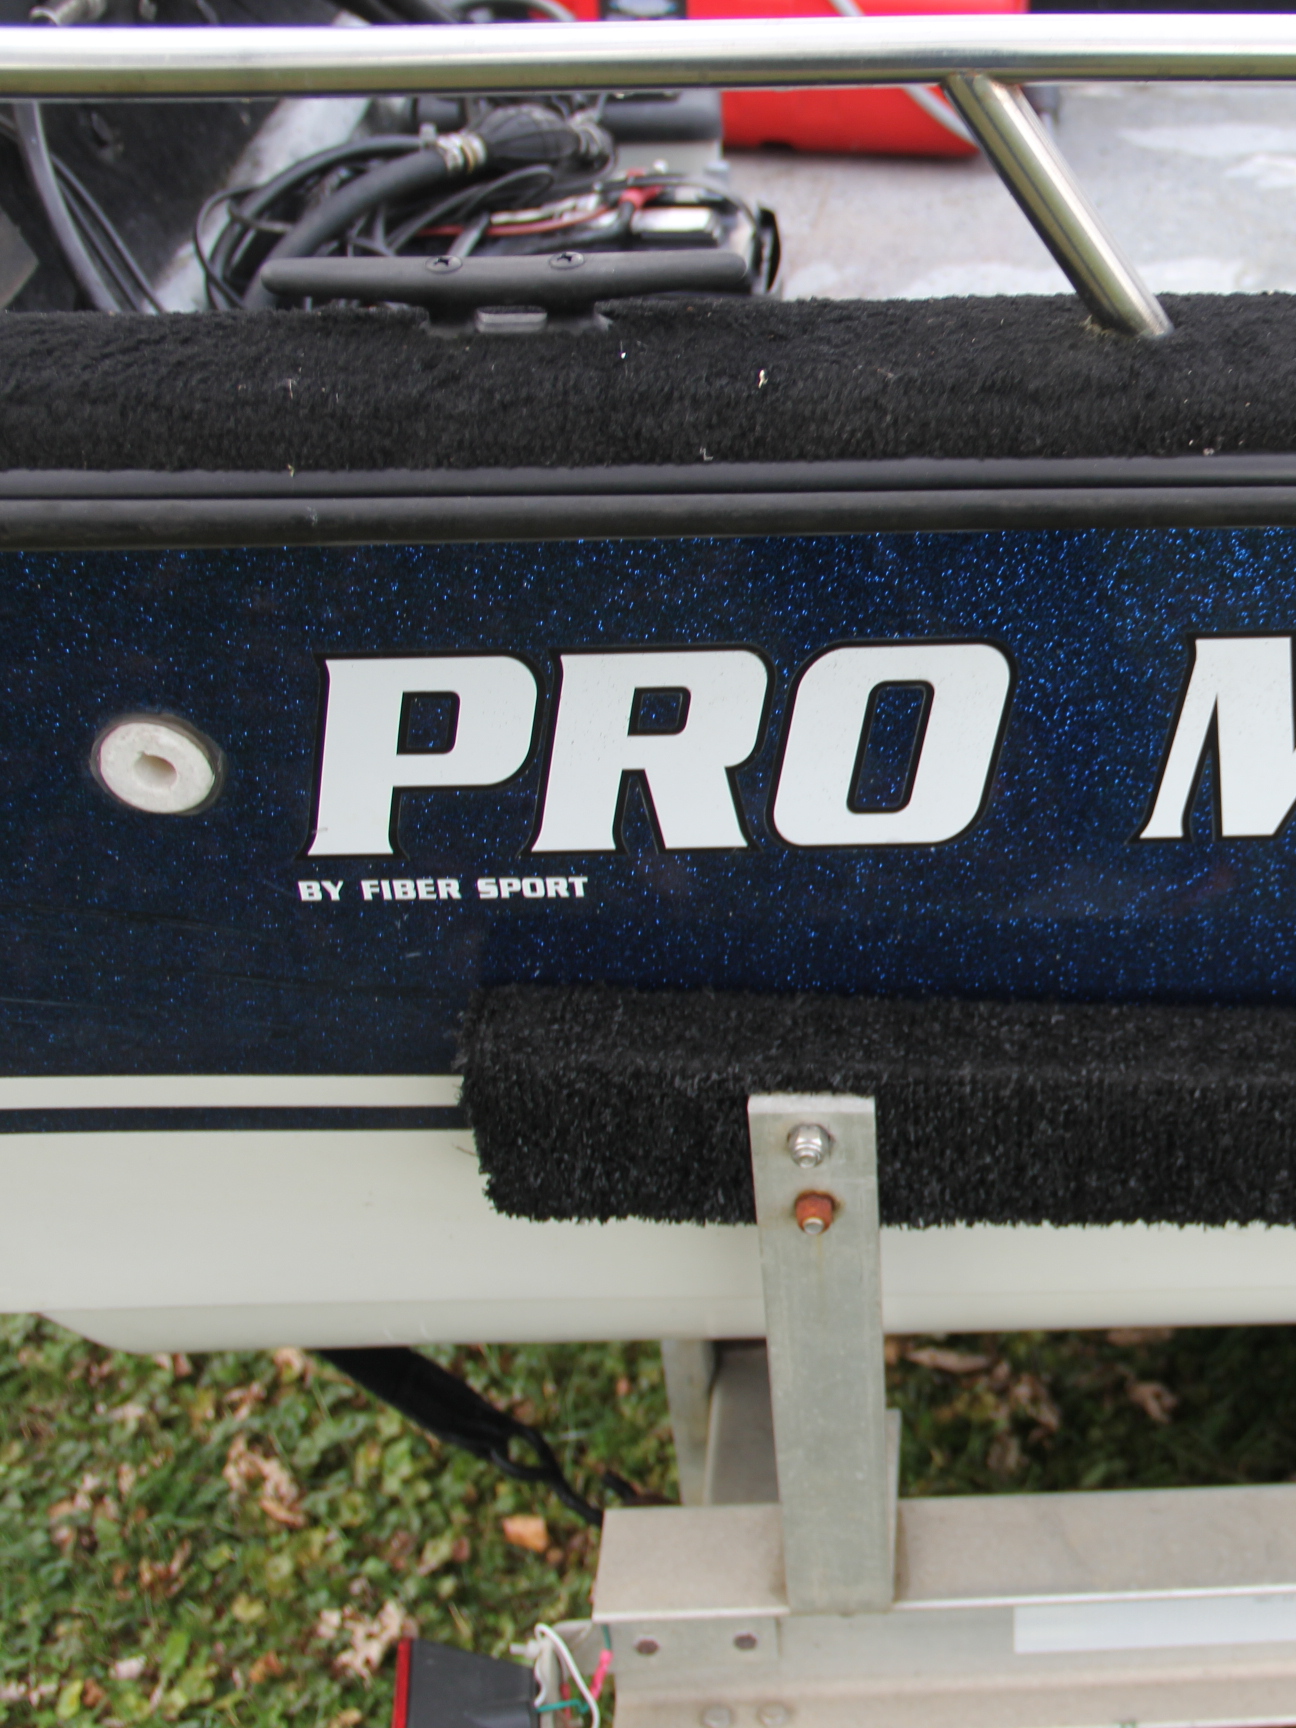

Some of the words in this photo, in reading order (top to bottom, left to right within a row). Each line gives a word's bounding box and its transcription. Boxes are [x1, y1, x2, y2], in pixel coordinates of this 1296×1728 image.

[308, 644, 1011, 857] PRO
[298, 879, 343, 901] BY
[361, 877, 461, 901] FIBER
[477, 876, 588, 899] SPORT
